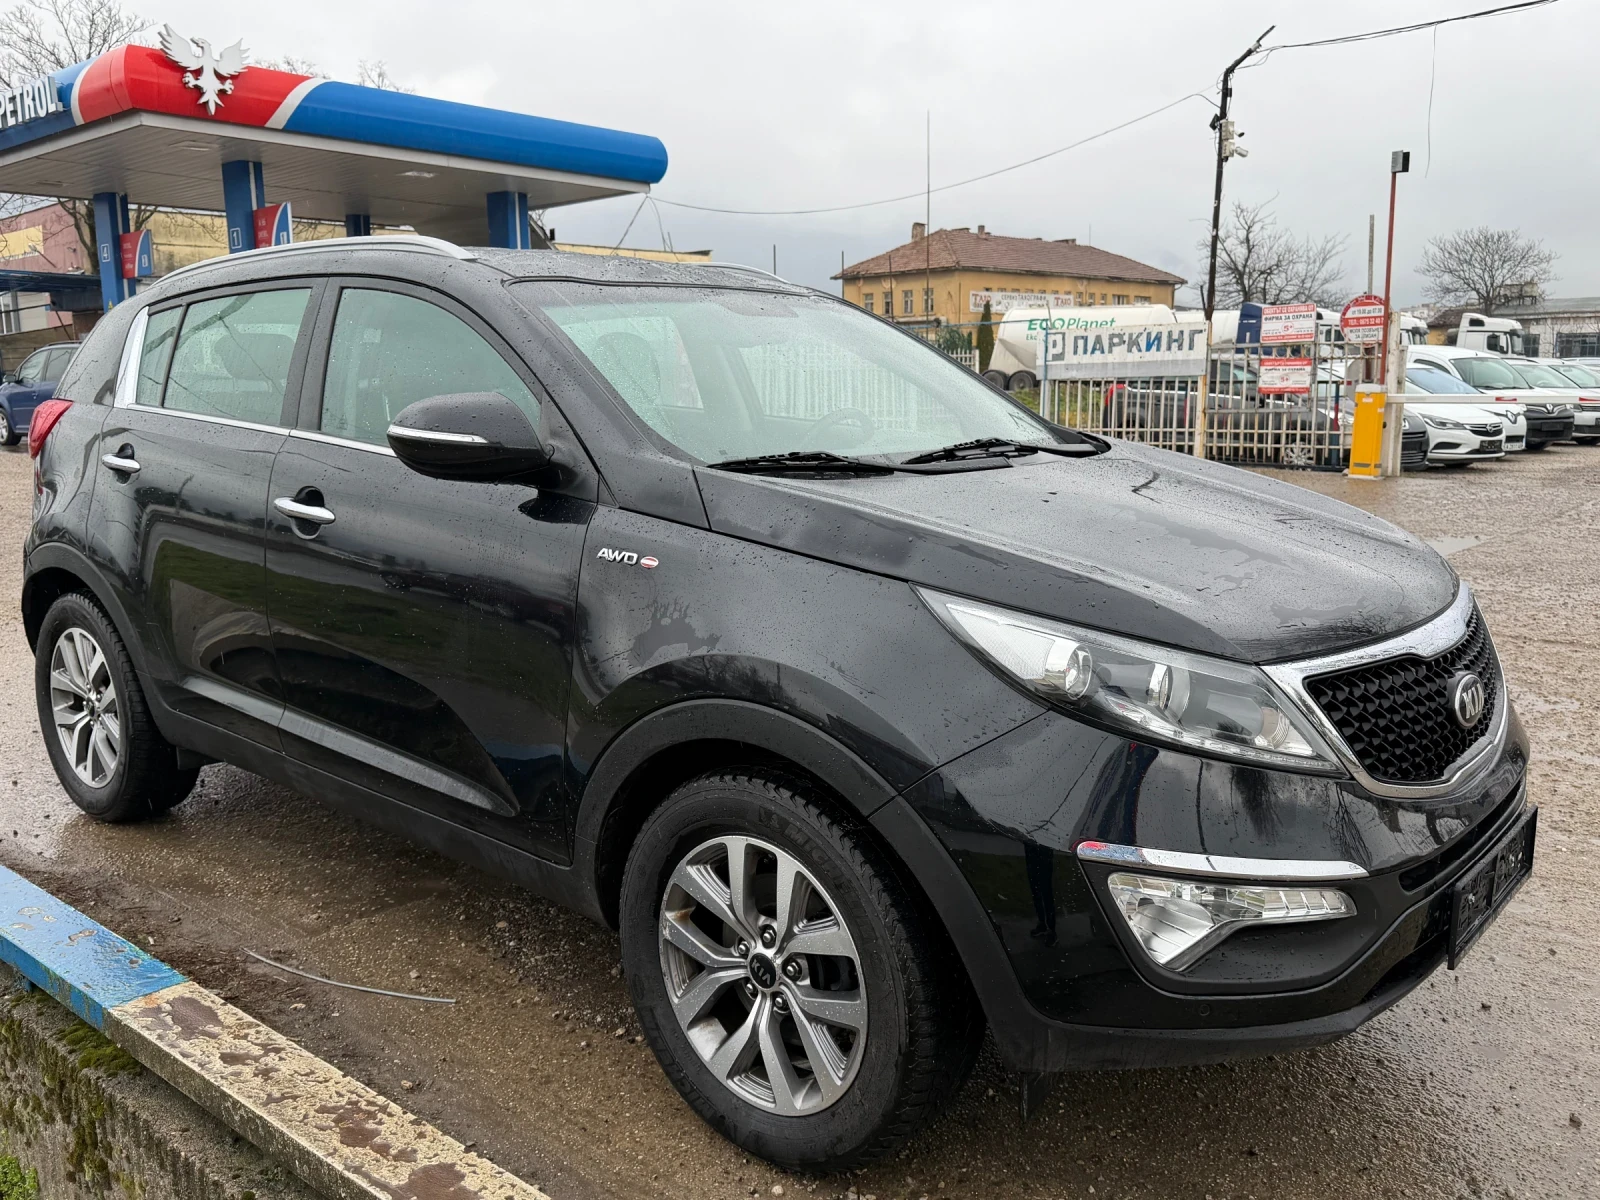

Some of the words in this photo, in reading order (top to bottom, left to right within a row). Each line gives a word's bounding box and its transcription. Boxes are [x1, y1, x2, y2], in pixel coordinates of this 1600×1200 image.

[0, 75, 58, 129] PETROL
[1073, 329, 1203, 356] ПАРКИНГ
[596, 547, 639, 565] AWD
[751, 959, 771, 986] KIA
